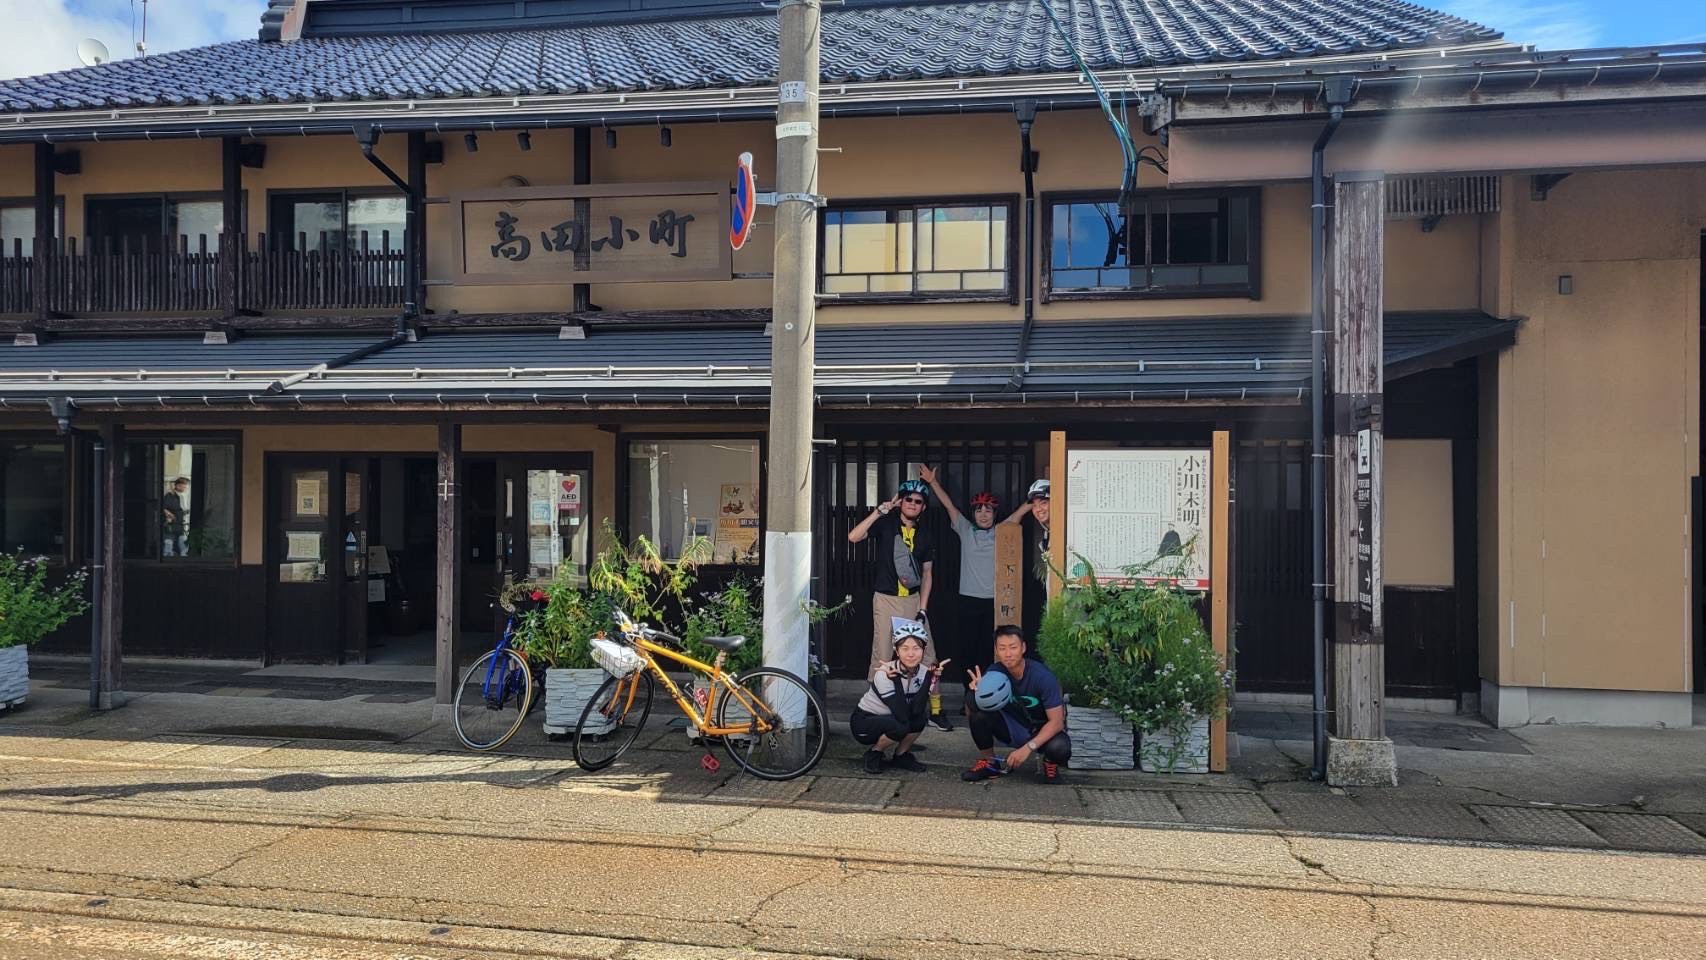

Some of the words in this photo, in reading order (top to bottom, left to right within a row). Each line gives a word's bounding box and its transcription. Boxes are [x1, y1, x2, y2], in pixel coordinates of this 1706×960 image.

[785, 88, 798, 99] 35
[490, 209, 695, 262] 高田小町
[1183, 455, 1200, 527] 小川未明
